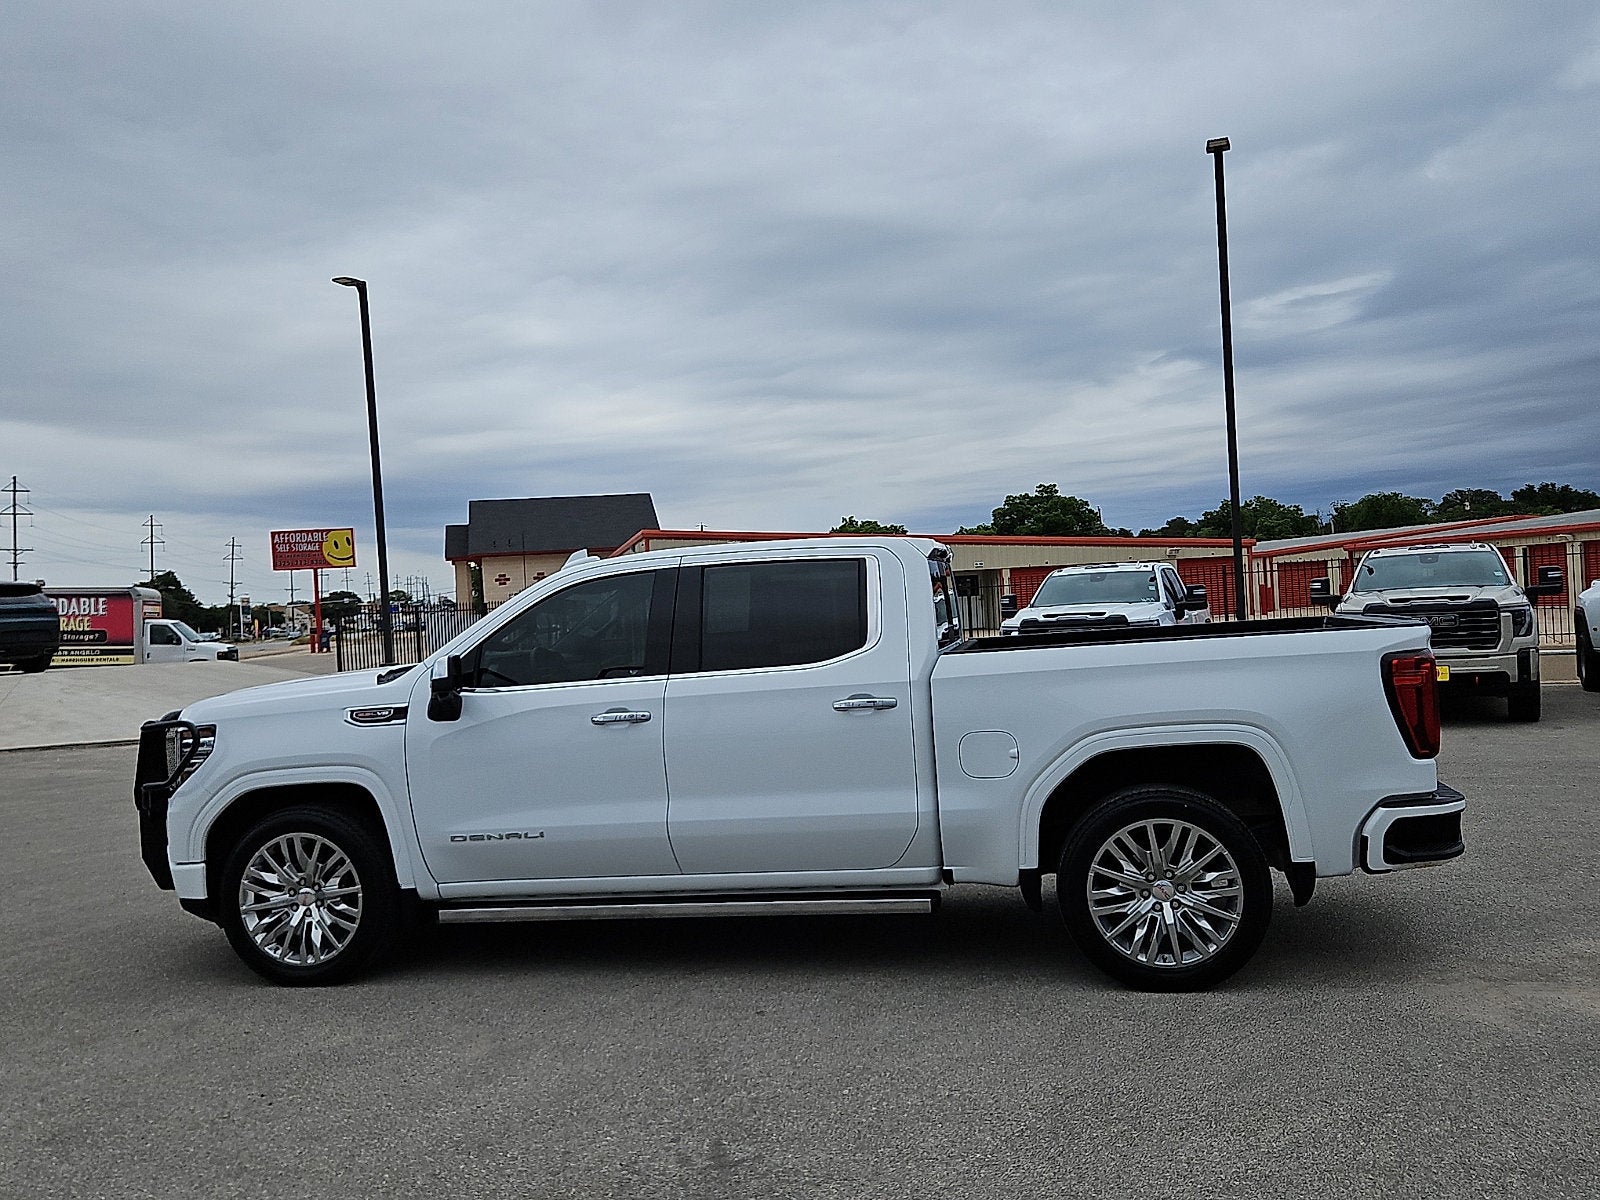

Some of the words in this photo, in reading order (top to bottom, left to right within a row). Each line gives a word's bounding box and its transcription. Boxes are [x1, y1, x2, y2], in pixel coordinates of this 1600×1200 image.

[274, 532, 328, 543] AFFORDABLE
[276, 543, 290, 552] SELF
[291, 542, 320, 551] STORAGE
[450, 831, 545, 842] DENALI
